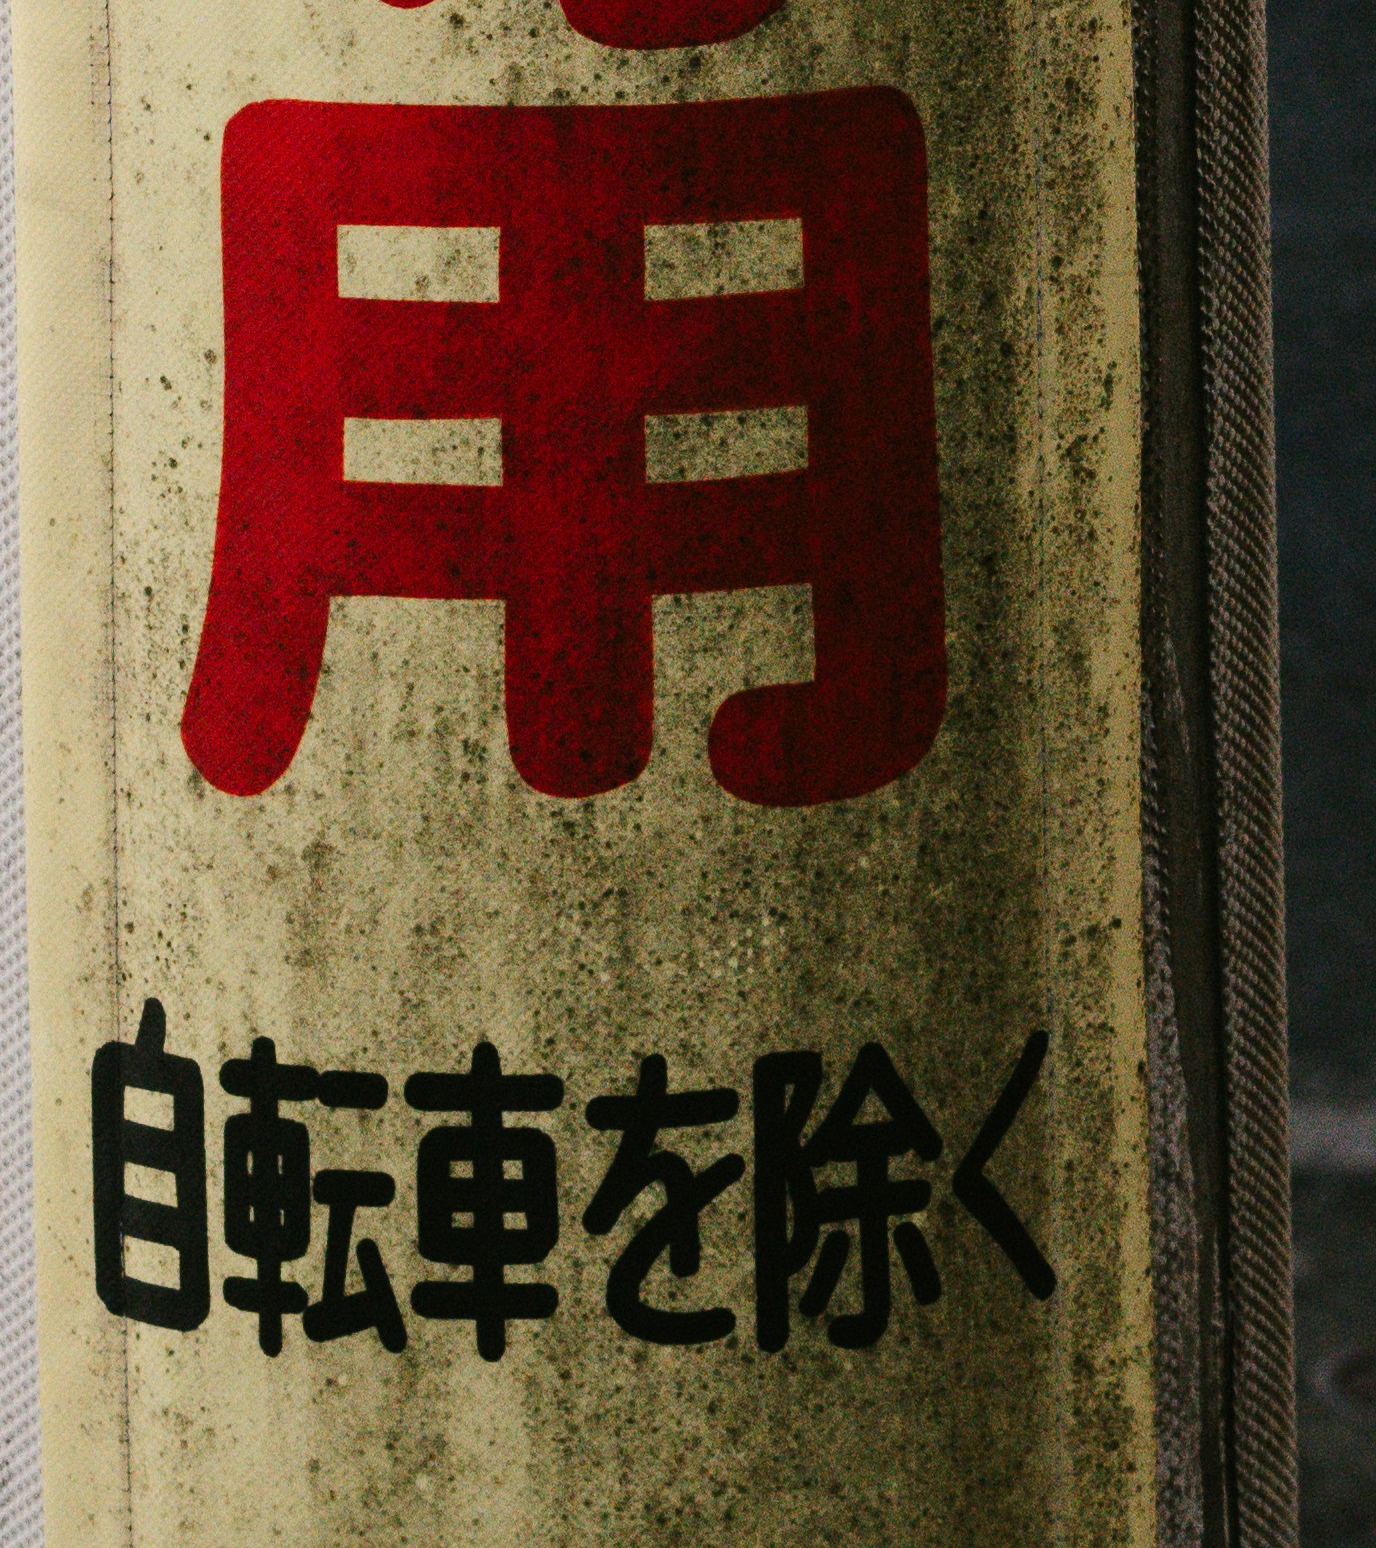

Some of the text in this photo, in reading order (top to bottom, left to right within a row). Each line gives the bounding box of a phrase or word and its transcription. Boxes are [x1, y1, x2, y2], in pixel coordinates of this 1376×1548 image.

[92, 997, 1056, 1363] 自転車を除く
